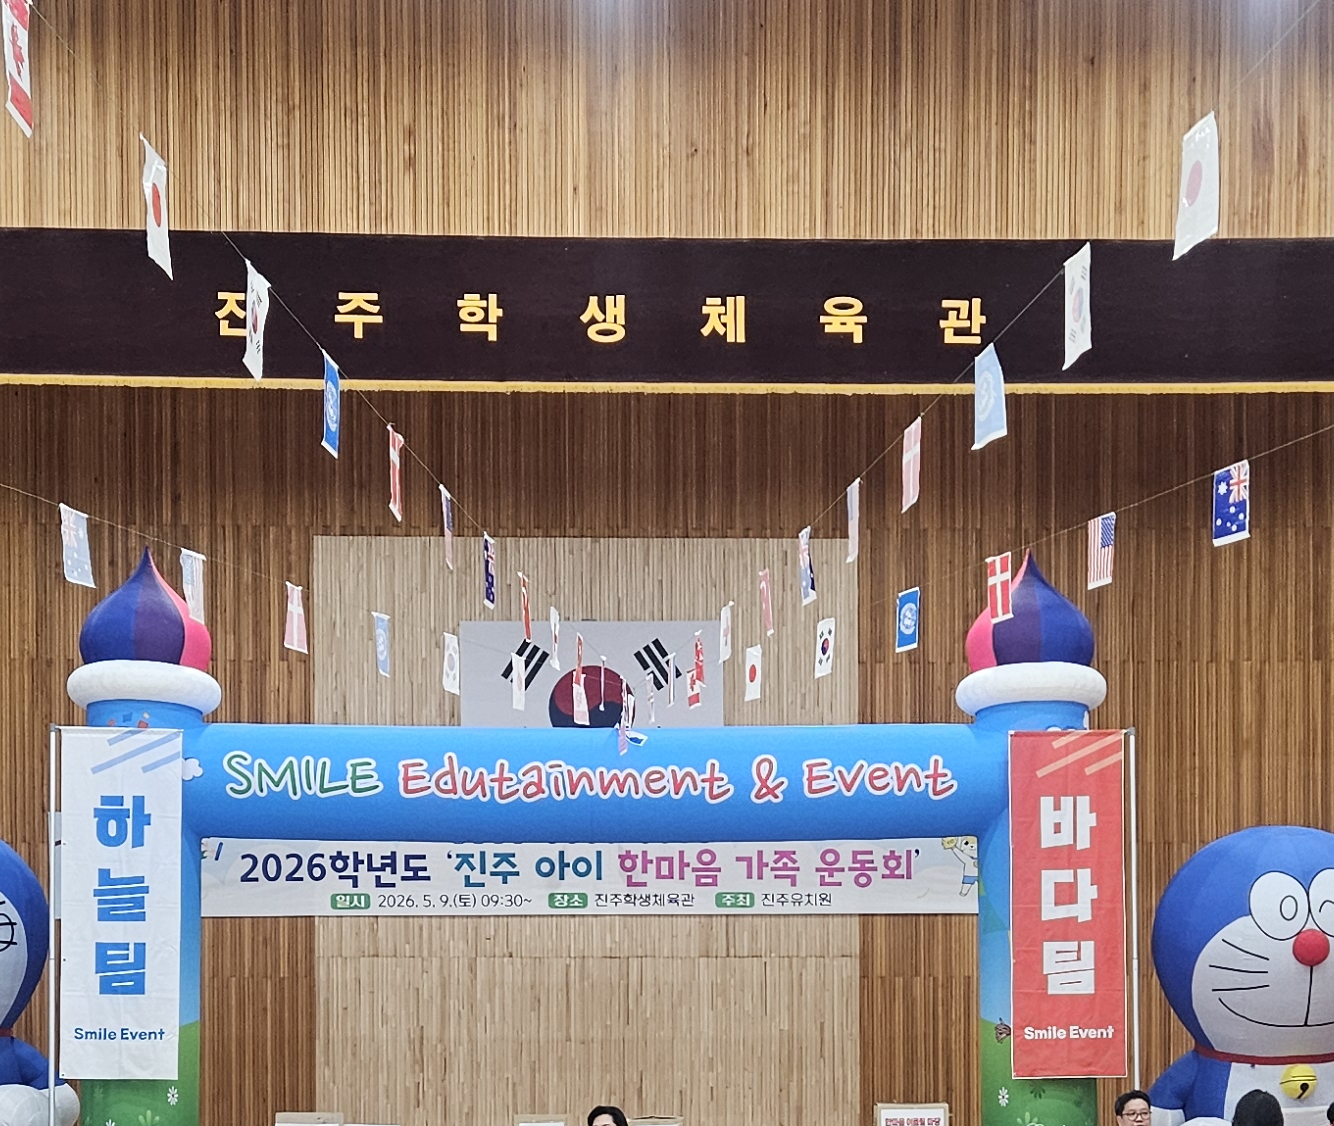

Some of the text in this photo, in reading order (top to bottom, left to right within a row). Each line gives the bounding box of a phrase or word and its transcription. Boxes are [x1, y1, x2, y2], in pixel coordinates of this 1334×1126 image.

[224, 752, 956, 803] SMILE Edutainment & Event
[240, 850, 431, 889] 2026학년도
[535, 850, 603, 881] 아이
[618, 848, 722, 888] 한마음
[736, 849, 801, 888] 가족
[93, 795, 152, 995] 하늘팀
[334, 894, 368, 907] 일시
[378, 894, 419, 909] 2026.
[481, 893, 533, 909] 09:30~
[552, 893, 695, 908] 장소 진주학생체육관
[721, 893, 833, 908] 주최 진주유치원
[1040, 795, 1099, 995] 바다팀
[74, 1026, 165, 1041] Smile Event
[1023, 1025, 1114, 1041] Smile Event
